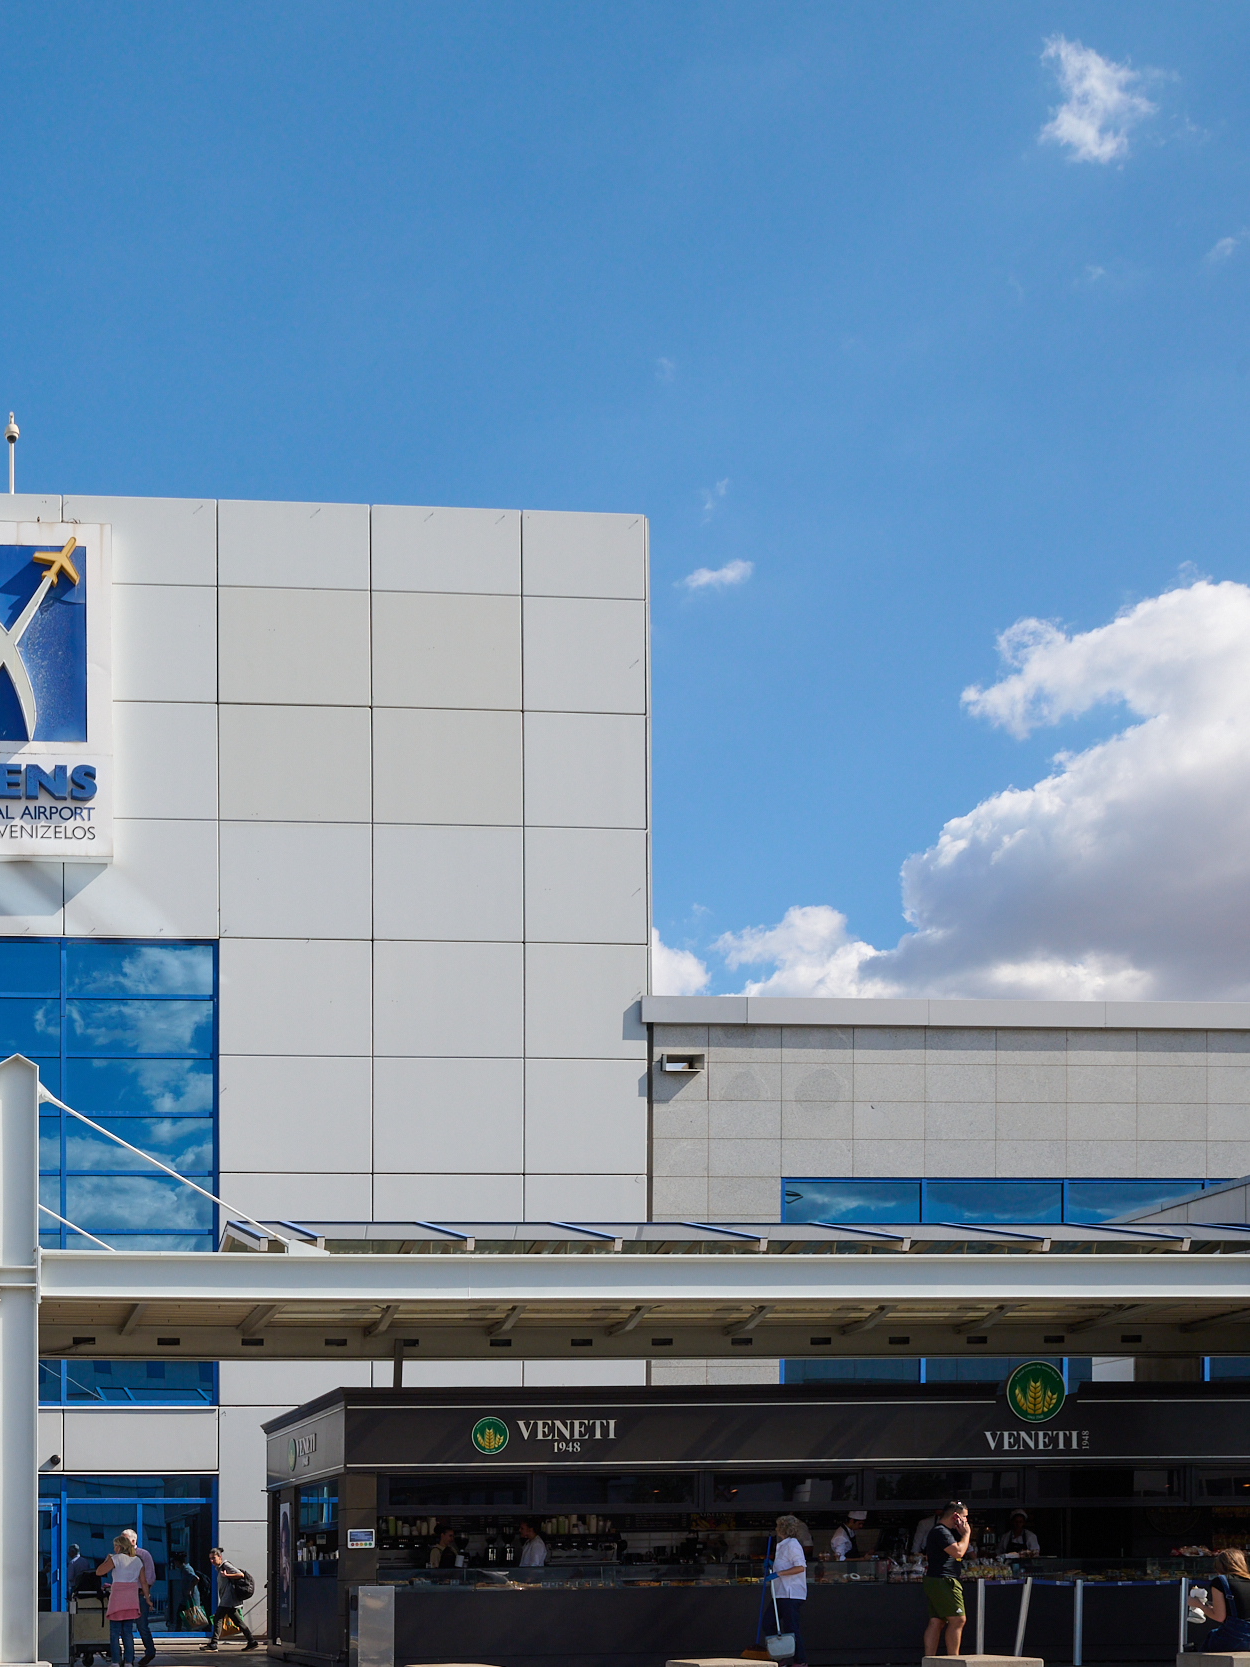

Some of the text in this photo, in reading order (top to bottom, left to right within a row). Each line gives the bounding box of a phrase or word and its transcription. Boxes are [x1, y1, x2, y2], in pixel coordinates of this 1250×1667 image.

[20, 805, 95, 822] AIRPORT
[517, 1419, 617, 1440] VENETI
[553, 1441, 581, 1453] 1948
[983, 1430, 1090, 1451] VENETI 1948
